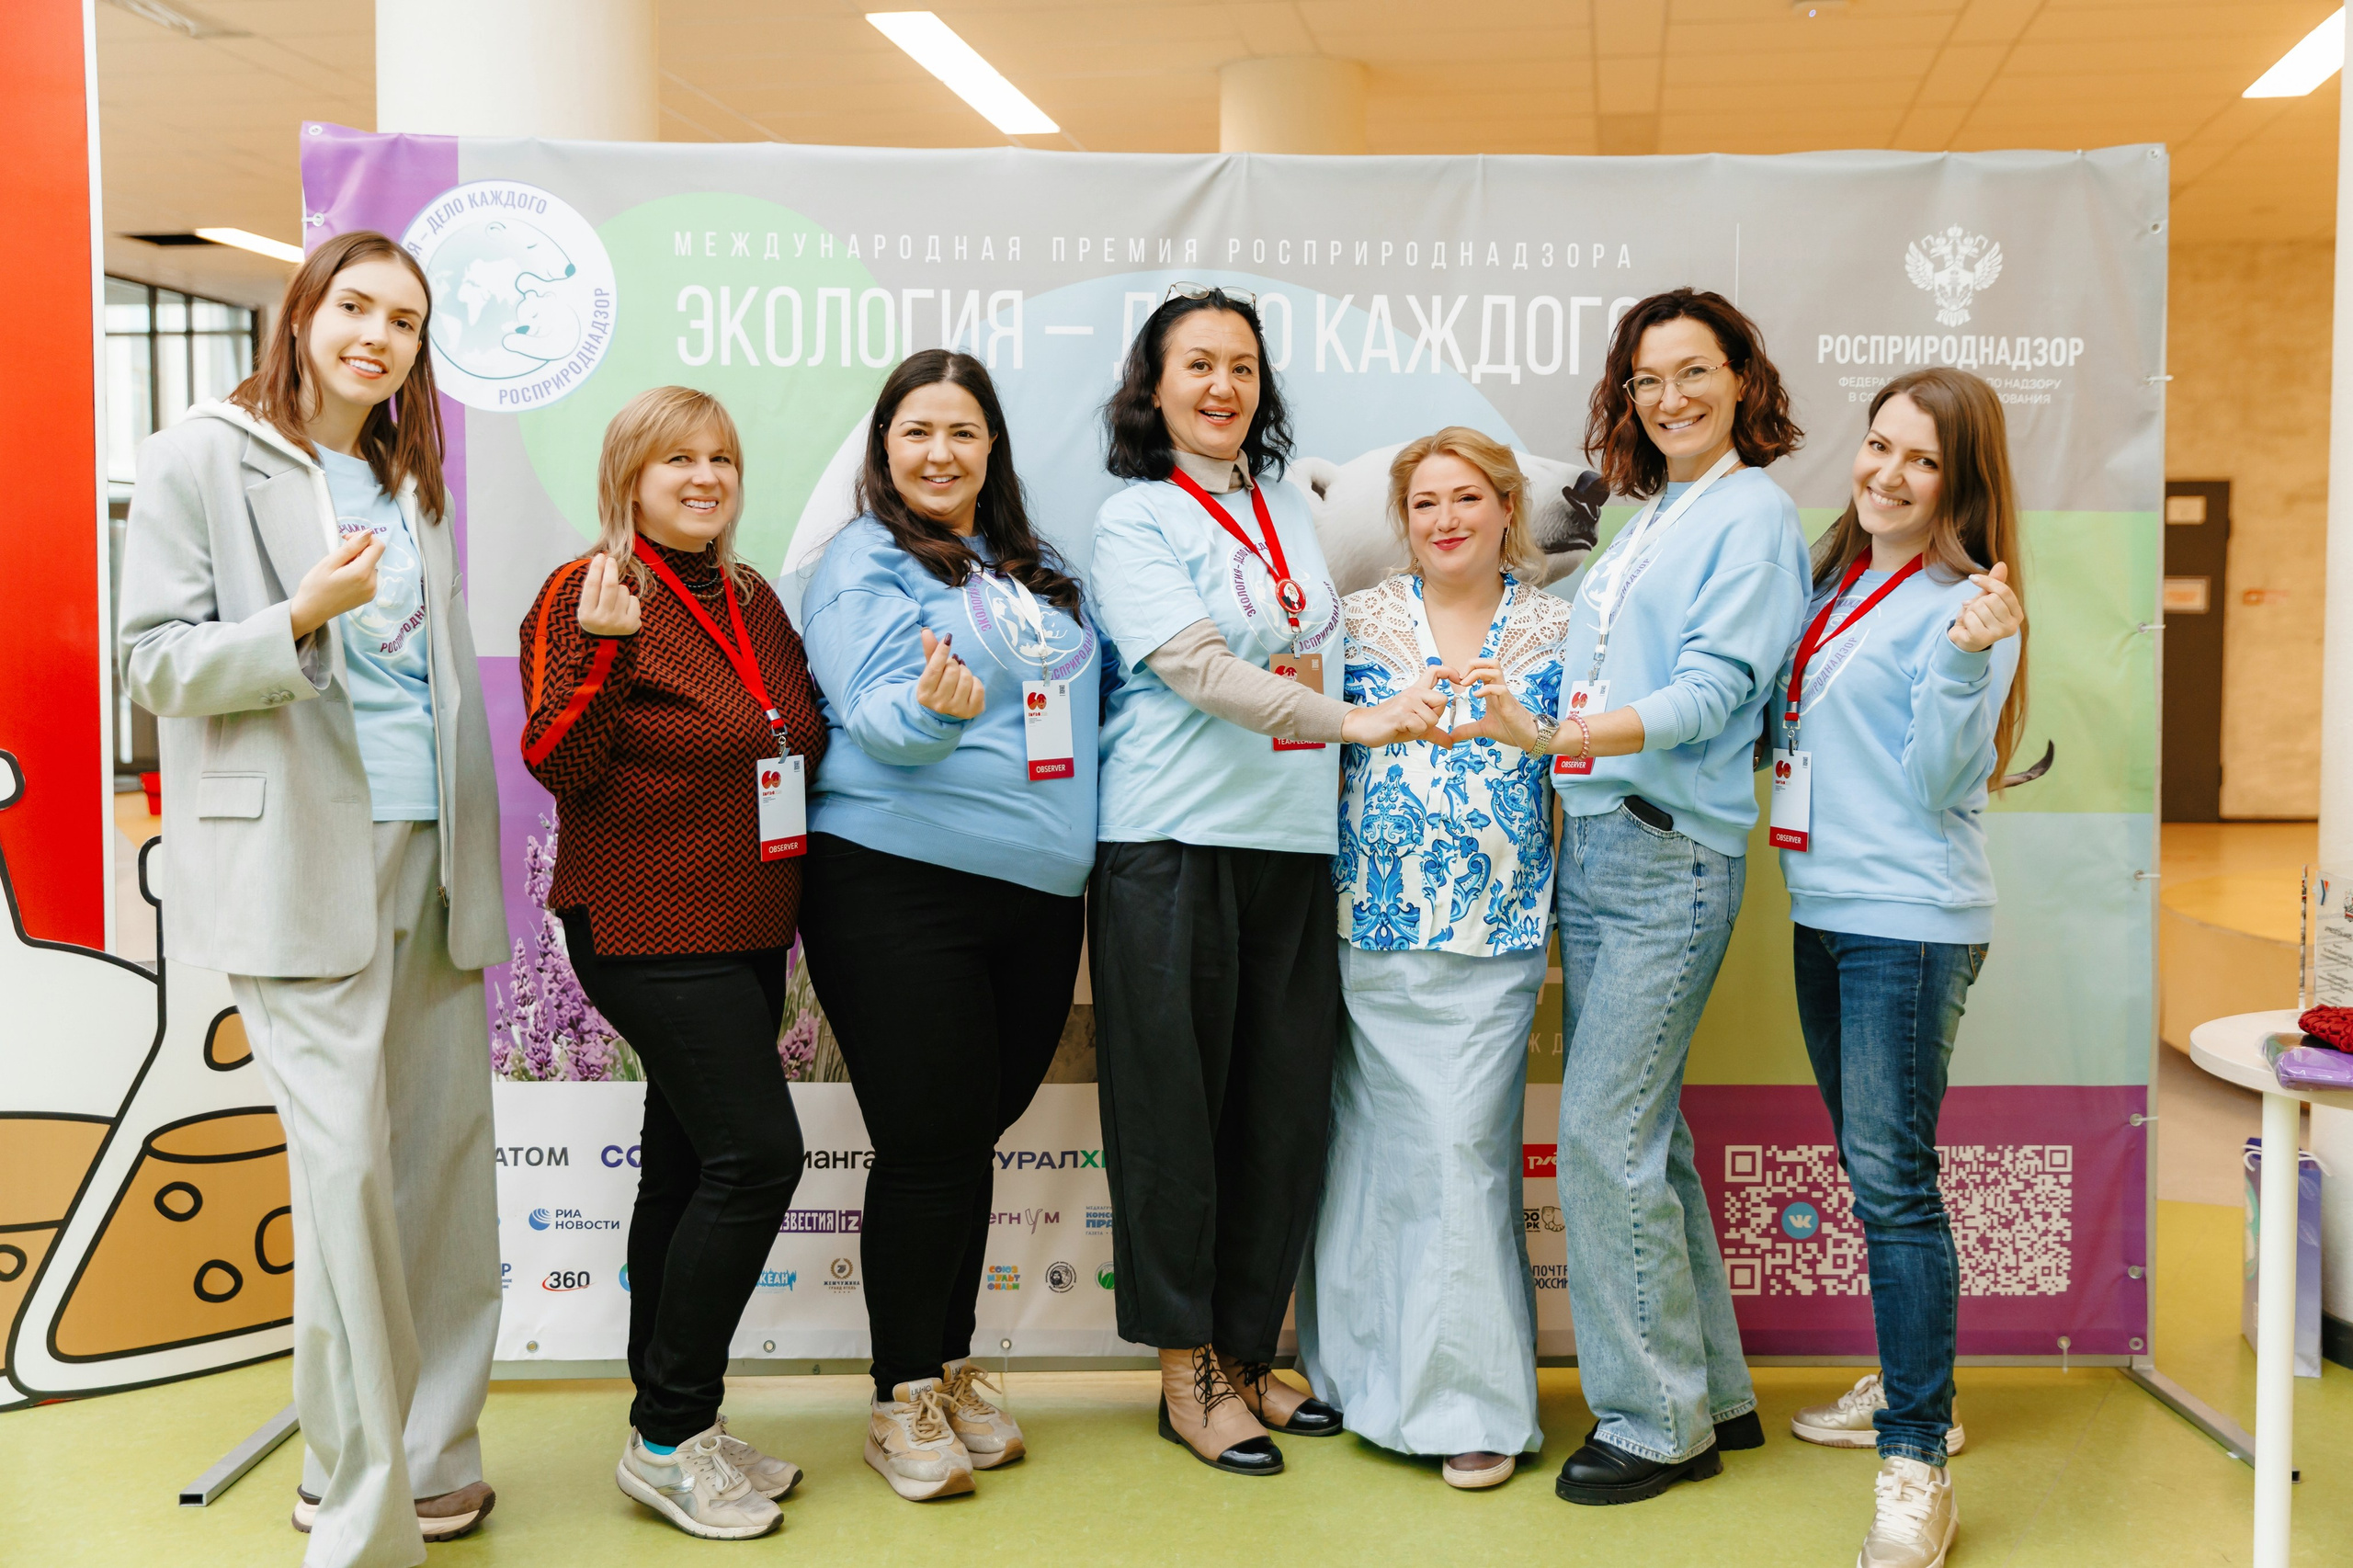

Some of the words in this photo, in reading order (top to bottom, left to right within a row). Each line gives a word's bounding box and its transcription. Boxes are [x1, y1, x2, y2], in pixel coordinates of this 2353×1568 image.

[426, 198, 465, 235] ДЕЛО
[467, 189, 548, 215] КАЖДОГО
[674, 231, 1021, 264] МЕЖДУНАРОДНАЯ
[1052, 236, 1199, 264] ПРЕМИЯ
[1228, 237, 1633, 270] РОСПРИРОДНАДЗОРА
[676, 285, 1023, 369] ЭКОЛОГИЯ
[498, 287, 610, 406] РОСПРИРОДНАДЗОР
[1818, 334, 2085, 372] РОСПРИРОДНАДЗОР
[2005, 378, 2063, 391] НАДЗОРУ
[1233, 568, 1256, 618] ЭКОЛОГИЯ
[969, 588, 992, 632] ЭКОЛОГИЯ
[1036, 764, 1066, 774] OBSERVER
[1561, 760, 1586, 769] OBSERVER
[768, 842, 799, 853] OBSERVER
[1776, 833, 1802, 845] OBSERVER
[995, 1150, 1106, 1169] УРАЛХ
[555, 1209, 582, 1219] РИА
[780, 1212, 834, 1231] ЗВЕСТИЯ
[841, 1210, 859, 1231] iz
[555, 1220, 620, 1231] НОВОСТИ
[986, 1274, 1020, 1282] МУЛЬТ
[988, 1265, 1018, 1274] СОЮЗ
[549, 1270, 591, 1290] 360
